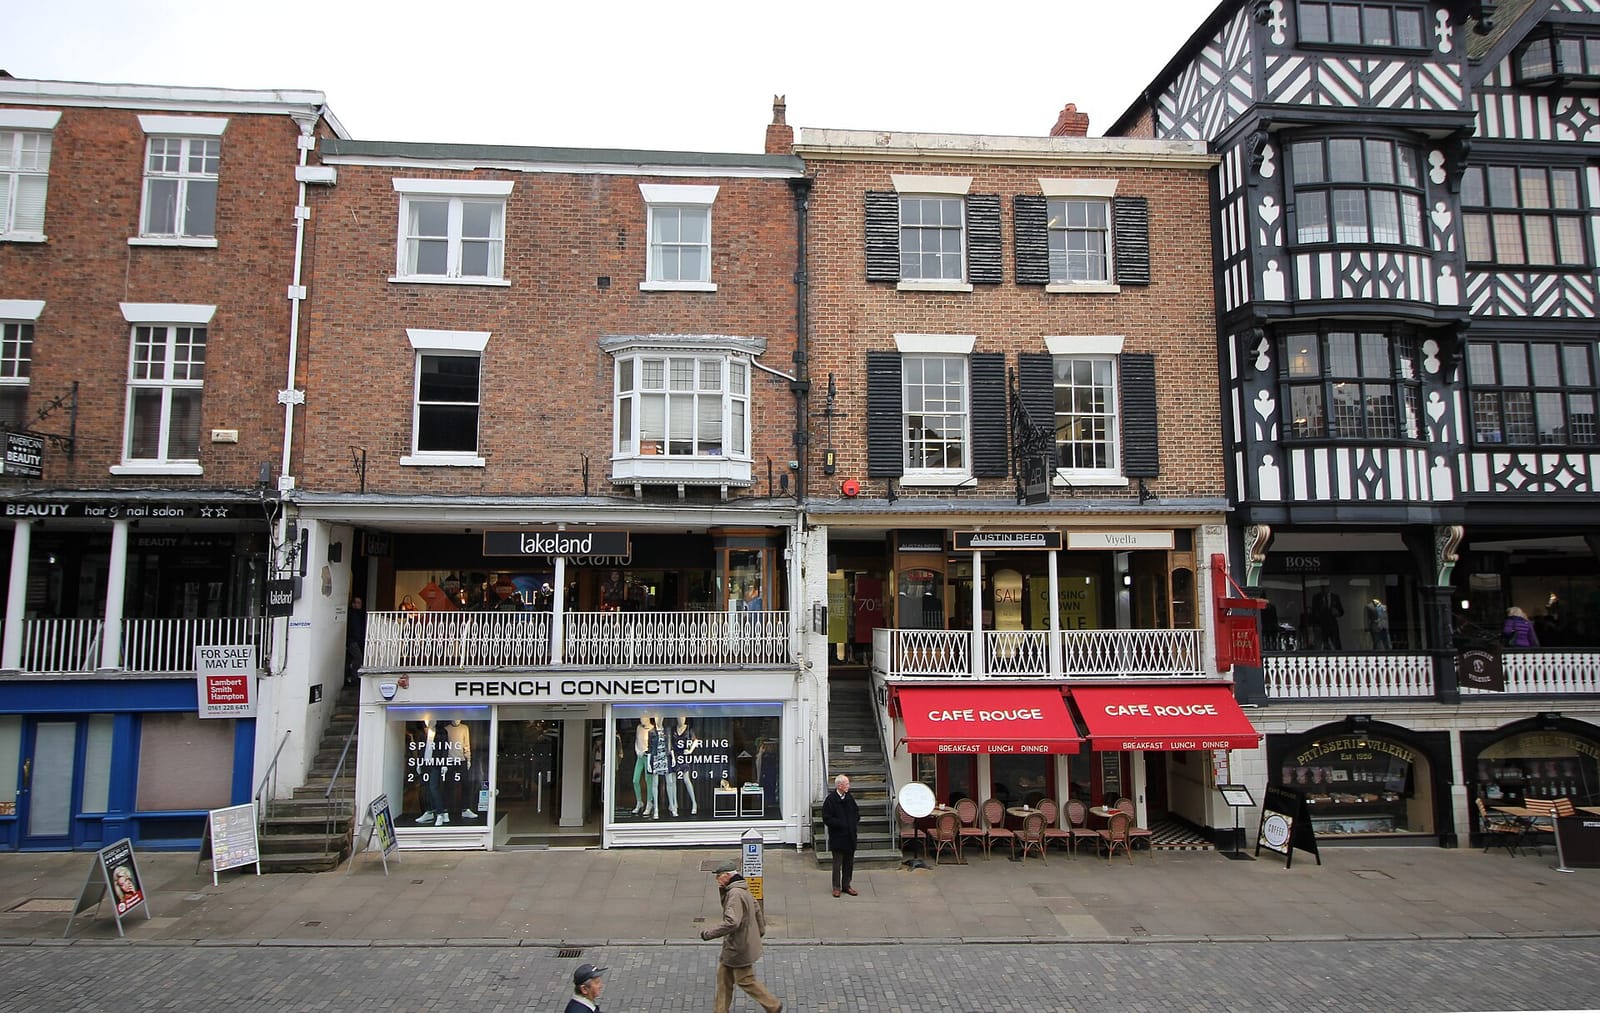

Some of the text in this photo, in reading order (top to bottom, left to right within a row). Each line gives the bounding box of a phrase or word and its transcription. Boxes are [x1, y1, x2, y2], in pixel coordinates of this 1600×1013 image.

[7, 451, 41, 466] BEAUTY
[5, 504, 69, 516] BEAUTY
[84, 504, 107, 516] hair
[126, 505, 149, 516] nail
[152, 505, 184, 517] salon
[137, 537, 177, 547] BEAUTY
[972, 533, 1045, 541] AUSTIN REED
[1104, 534, 1137, 546] Viyella
[520, 533, 592, 554] lakeland
[1285, 556, 1321, 568] BOSS
[270, 589, 293, 605] lakeland
[201, 649, 221, 659] FOR
[205, 659, 249, 669] MAY LET
[454, 679, 716, 697] FRENCH CONNECTION
[210, 693, 245, 701] Hampton
[979, 708, 1044, 722] ROUGE
[1153, 704, 1219, 717] ROUGE
[408, 741, 462, 751] SPRING
[677, 739, 729, 748] SPRING
[938, 744, 1049, 752] BREAKFAST LUNCH DINNER
[1122, 742, 1163, 750] BREAKFAST
[1202, 741, 1230, 749] DINNER
[1296, 739, 1417, 766] PATISSERIE VALERIE
[407, 757, 462, 766] SUMMER
[677, 754, 729, 764] SUMMER
[1268, 823, 1285, 837] COFFEE
